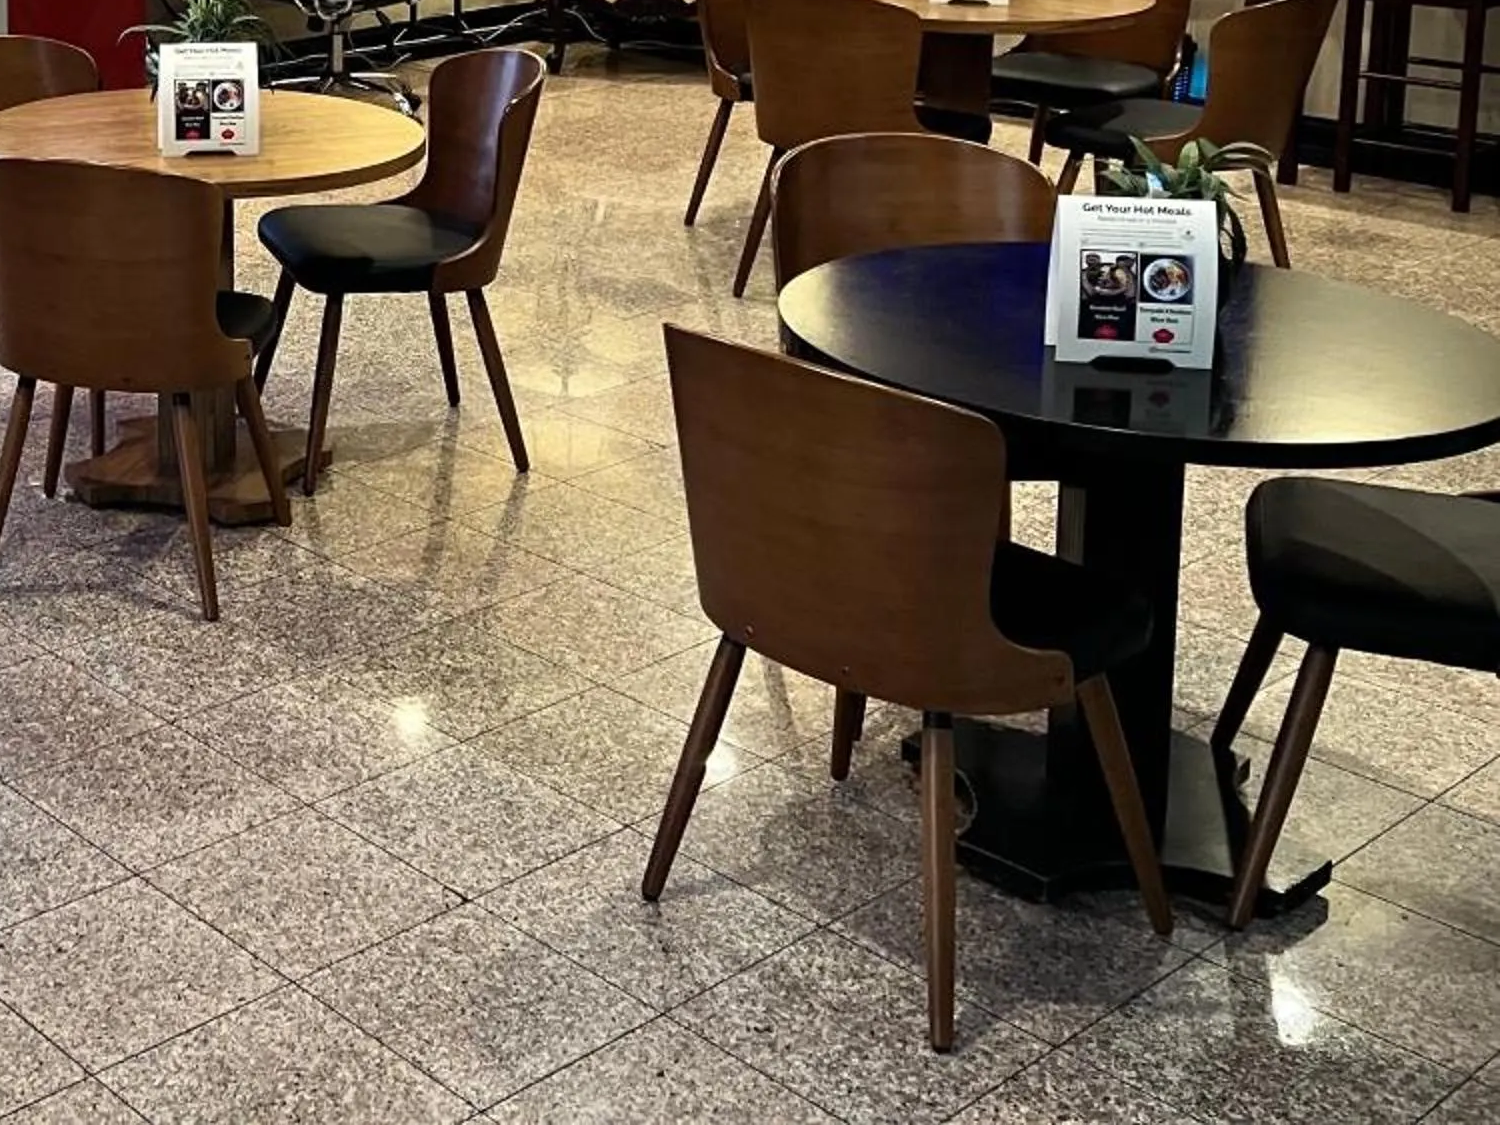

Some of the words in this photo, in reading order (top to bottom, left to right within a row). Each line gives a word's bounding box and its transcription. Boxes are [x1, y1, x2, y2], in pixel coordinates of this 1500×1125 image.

[1082, 202, 1103, 213] Get
[1105, 203, 1131, 214] Your
[1133, 205, 1155, 215] Hot
[1157, 206, 1192, 217] Meals
